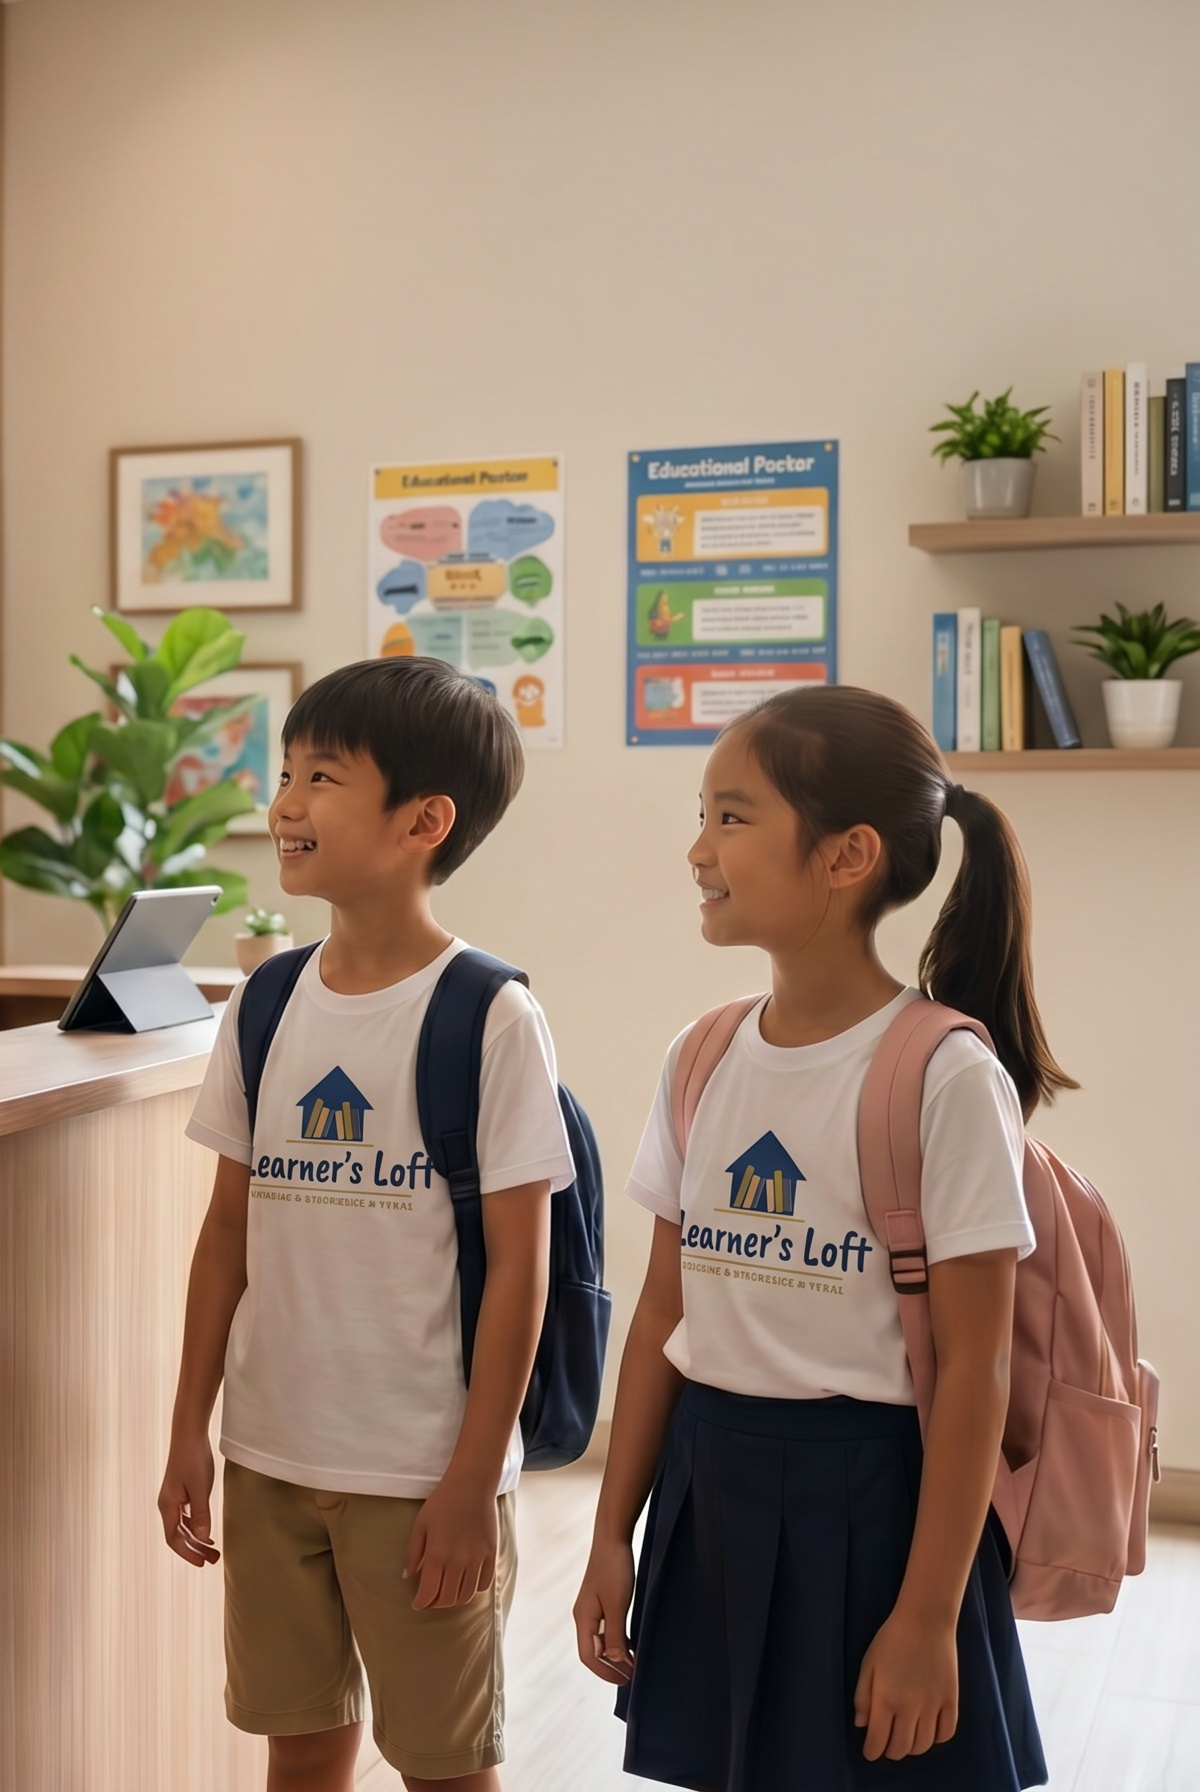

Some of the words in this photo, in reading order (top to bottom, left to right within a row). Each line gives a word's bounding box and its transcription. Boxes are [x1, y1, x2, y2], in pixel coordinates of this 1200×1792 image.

[647, 456, 749, 480] Educational
[250, 1151, 364, 1185] earner's
[803, 1227, 873, 1273] Loft
